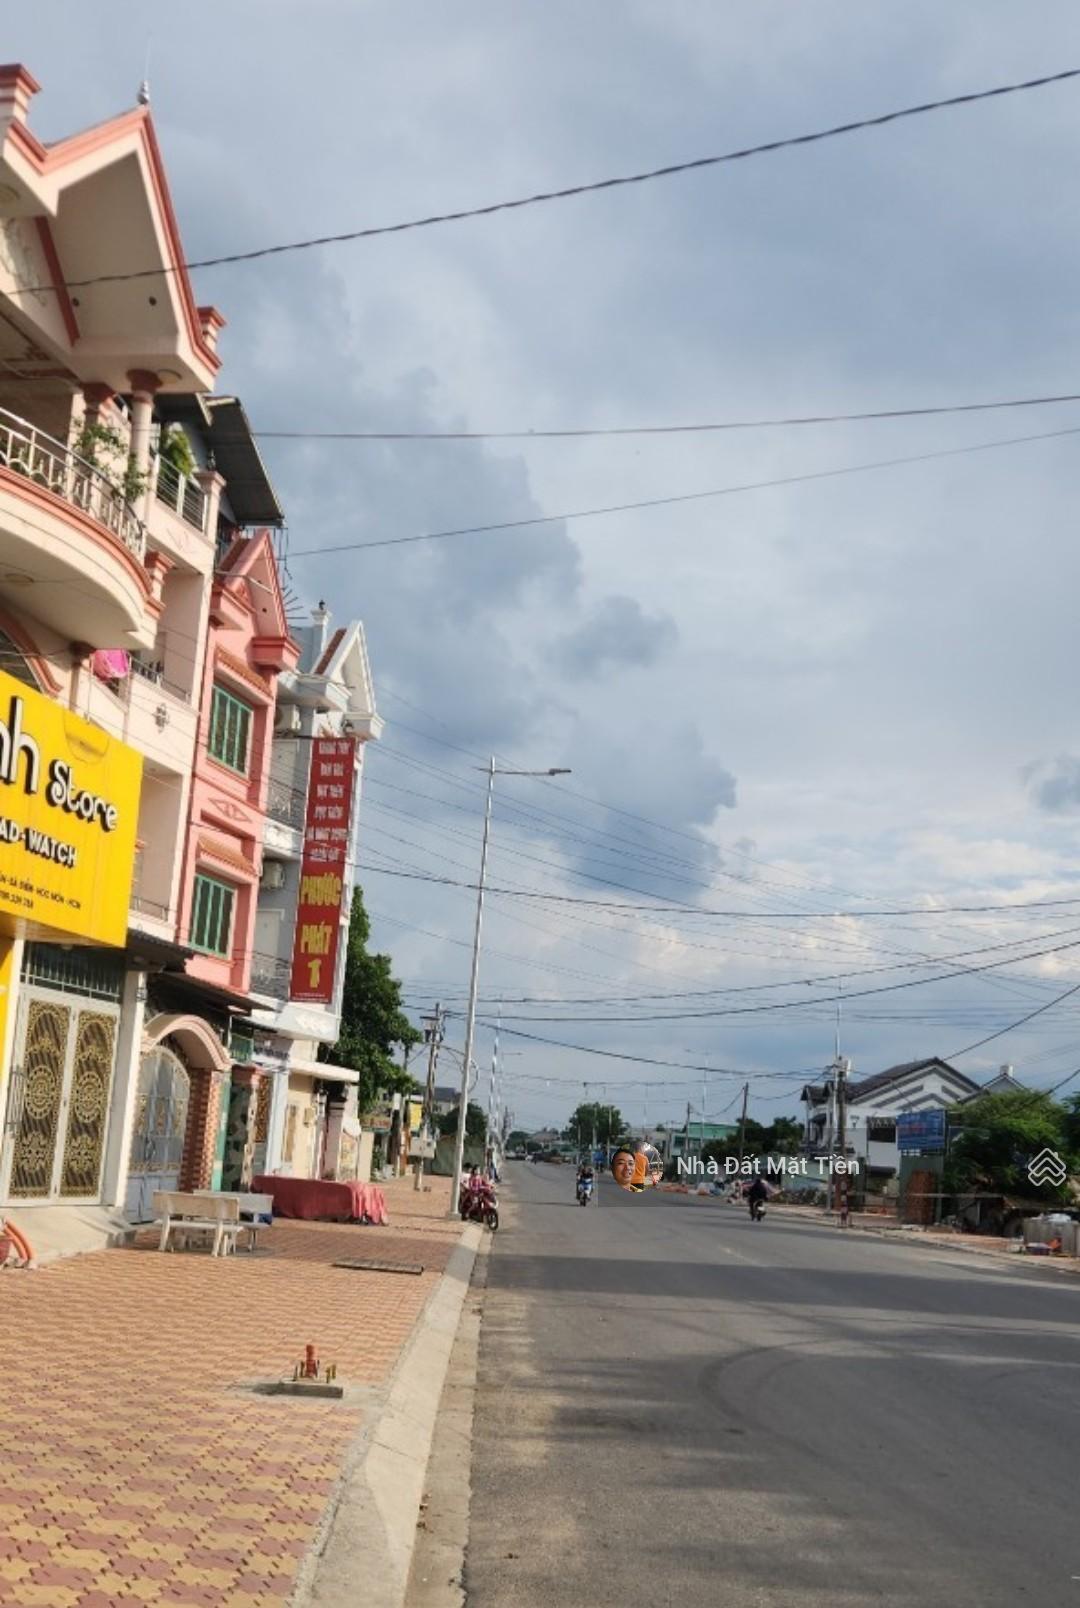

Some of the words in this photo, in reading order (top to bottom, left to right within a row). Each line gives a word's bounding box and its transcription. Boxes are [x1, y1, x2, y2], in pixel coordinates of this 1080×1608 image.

[46, 759, 118, 832] Store
[300, 920, 333, 955] PHÁT
[308, 958, 322, 989] 1
